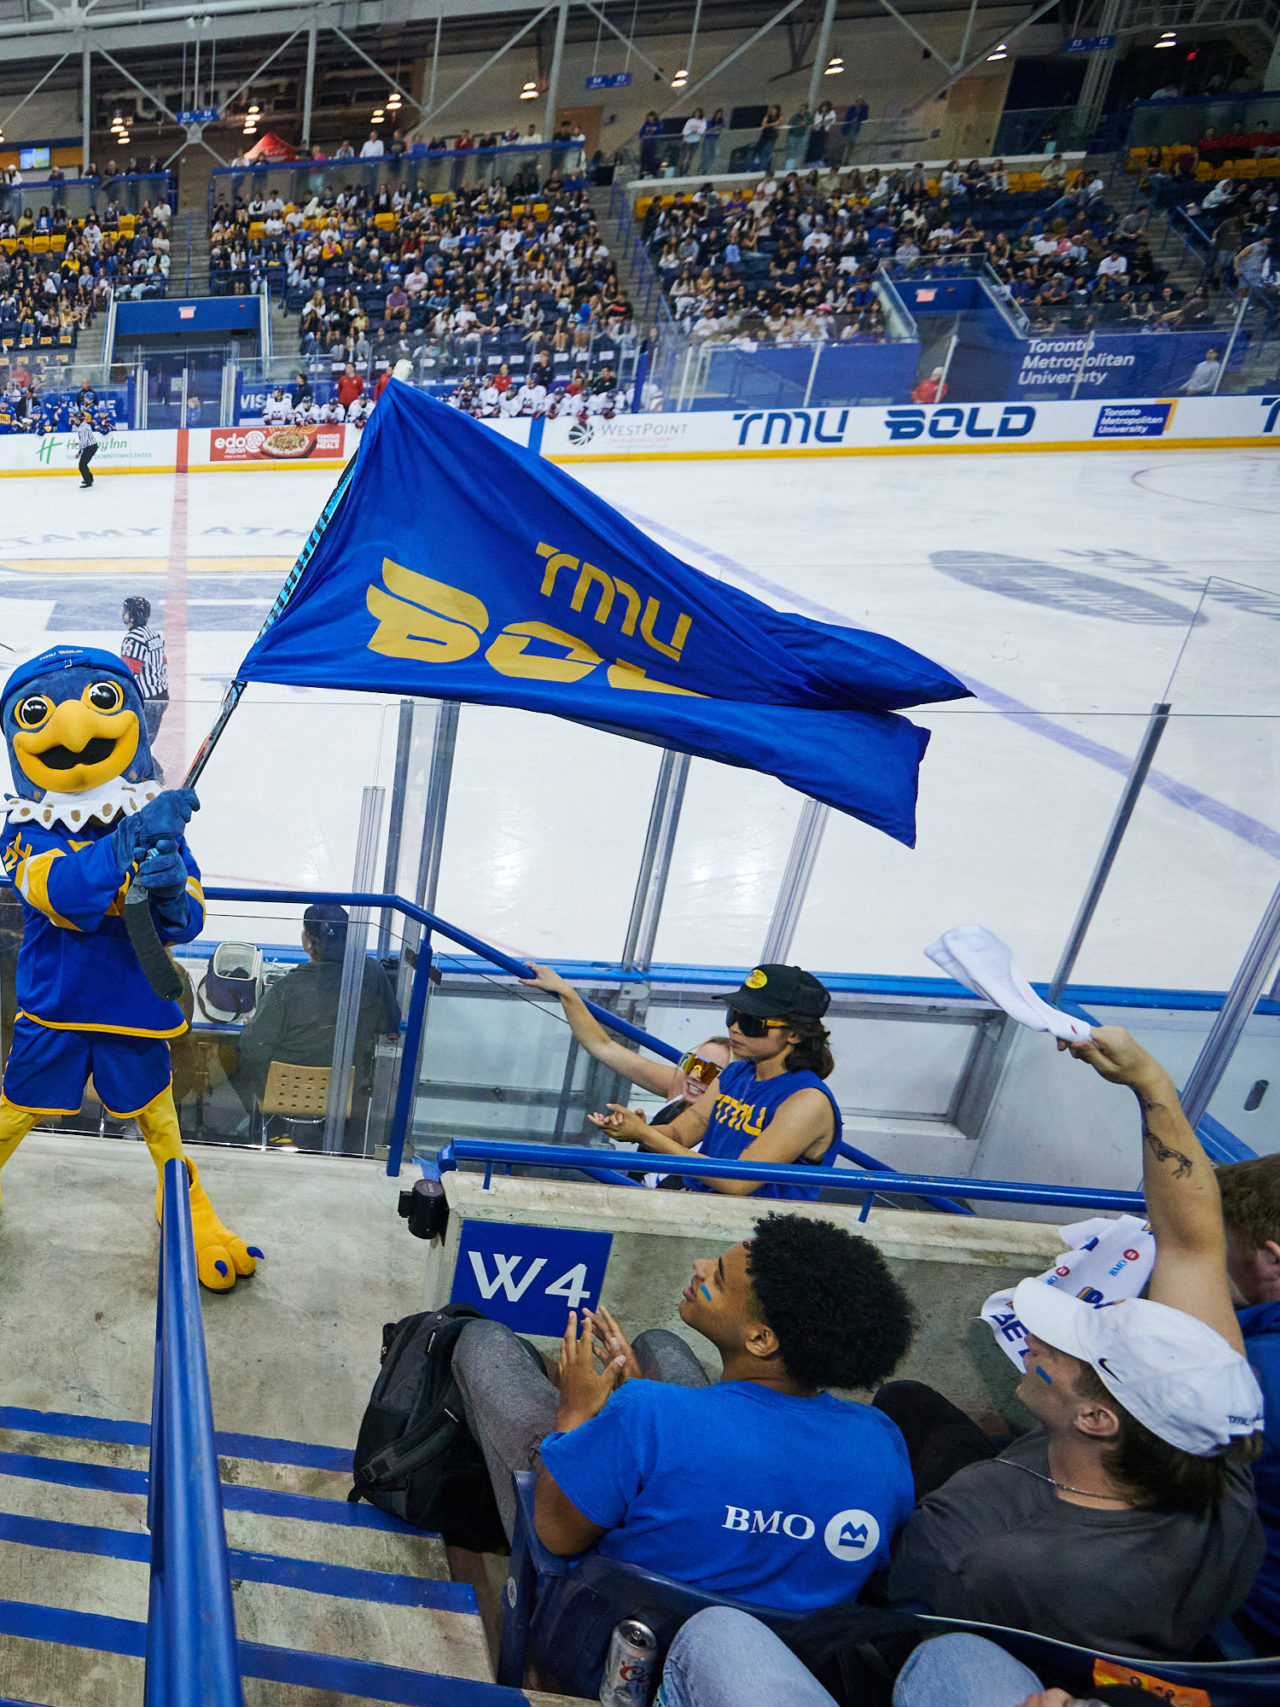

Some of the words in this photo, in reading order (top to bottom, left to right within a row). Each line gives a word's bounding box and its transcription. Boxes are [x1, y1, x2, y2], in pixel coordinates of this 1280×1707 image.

[1022, 353, 1136, 371] Metropolitan
[1018, 371, 1108, 386] University
[732, 410, 850, 446] TMU
[884, 405, 1037, 441] BOLD
[1098, 425, 1148, 434] University
[1101, 416, 1163, 427] Metropolitan
[109, 438, 128, 449] Inn
[215, 433, 246, 449] edo
[535, 541, 692, 662] TMU
[715, 1093, 768, 1137] TMU
[1108, 1259, 1128, 1277] BMO
[720, 1494, 816, 1541] BMO
